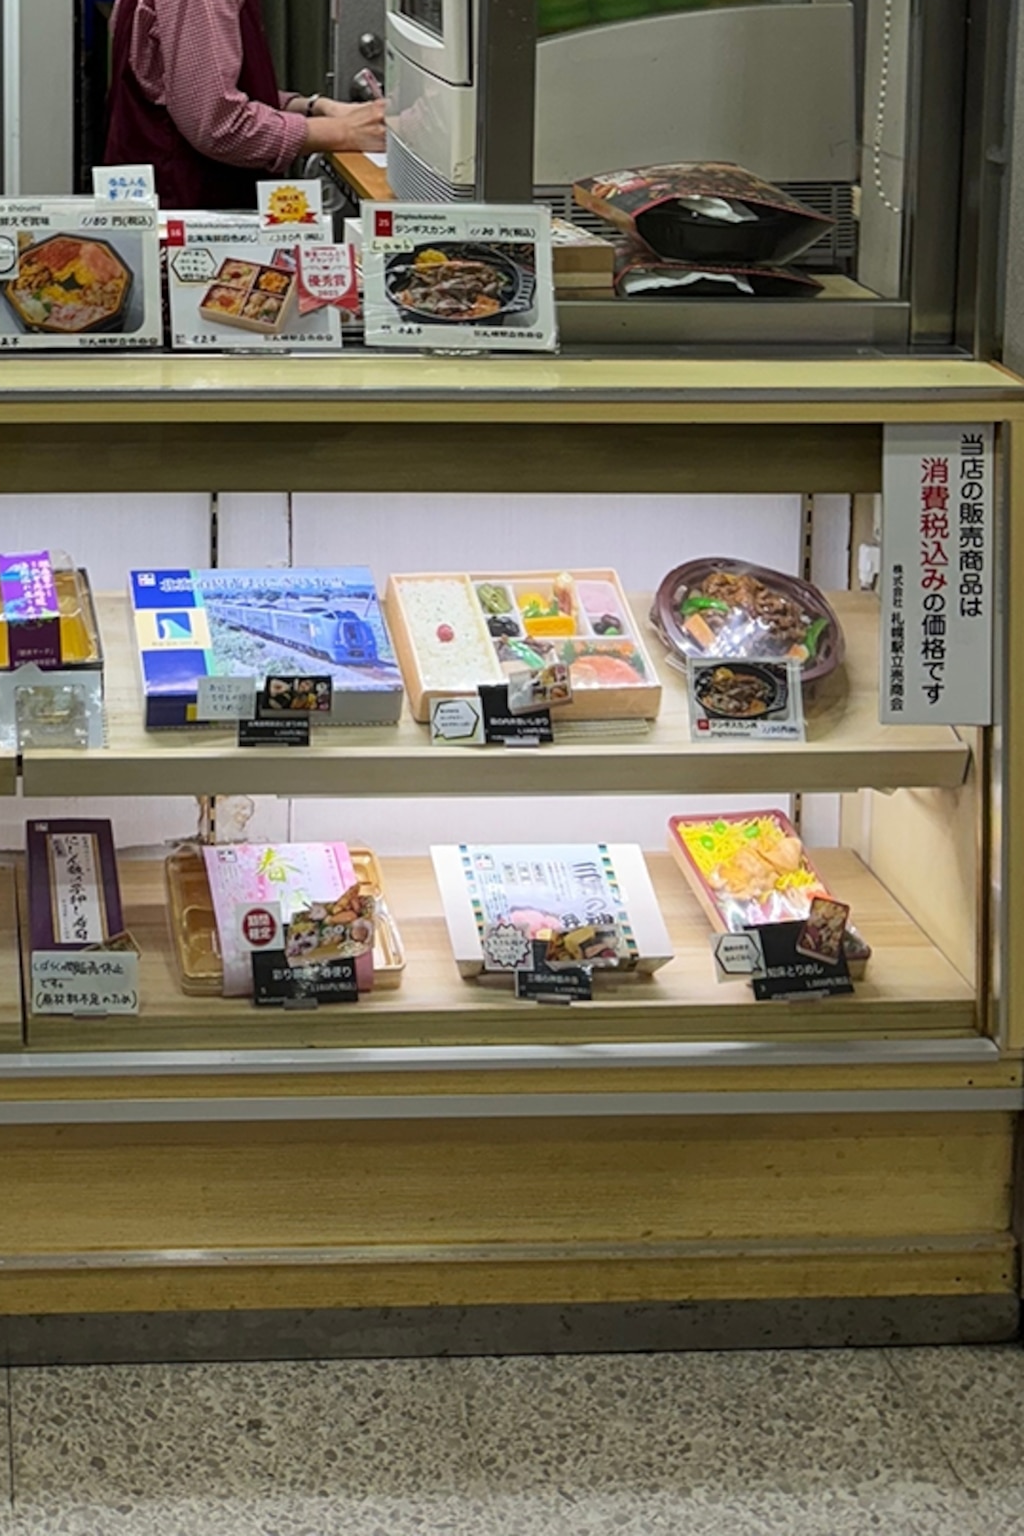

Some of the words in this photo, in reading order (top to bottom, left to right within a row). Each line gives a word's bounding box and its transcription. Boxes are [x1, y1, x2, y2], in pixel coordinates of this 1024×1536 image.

[308, 275, 346, 288] 優秀賞
[959, 433, 985, 617] 当店の販売商品は
[892, 564, 904, 608] 株式会社
[920, 456, 949, 705] 消費税込みの価格です
[890, 611, 905, 712] 札幌駅立売商会
